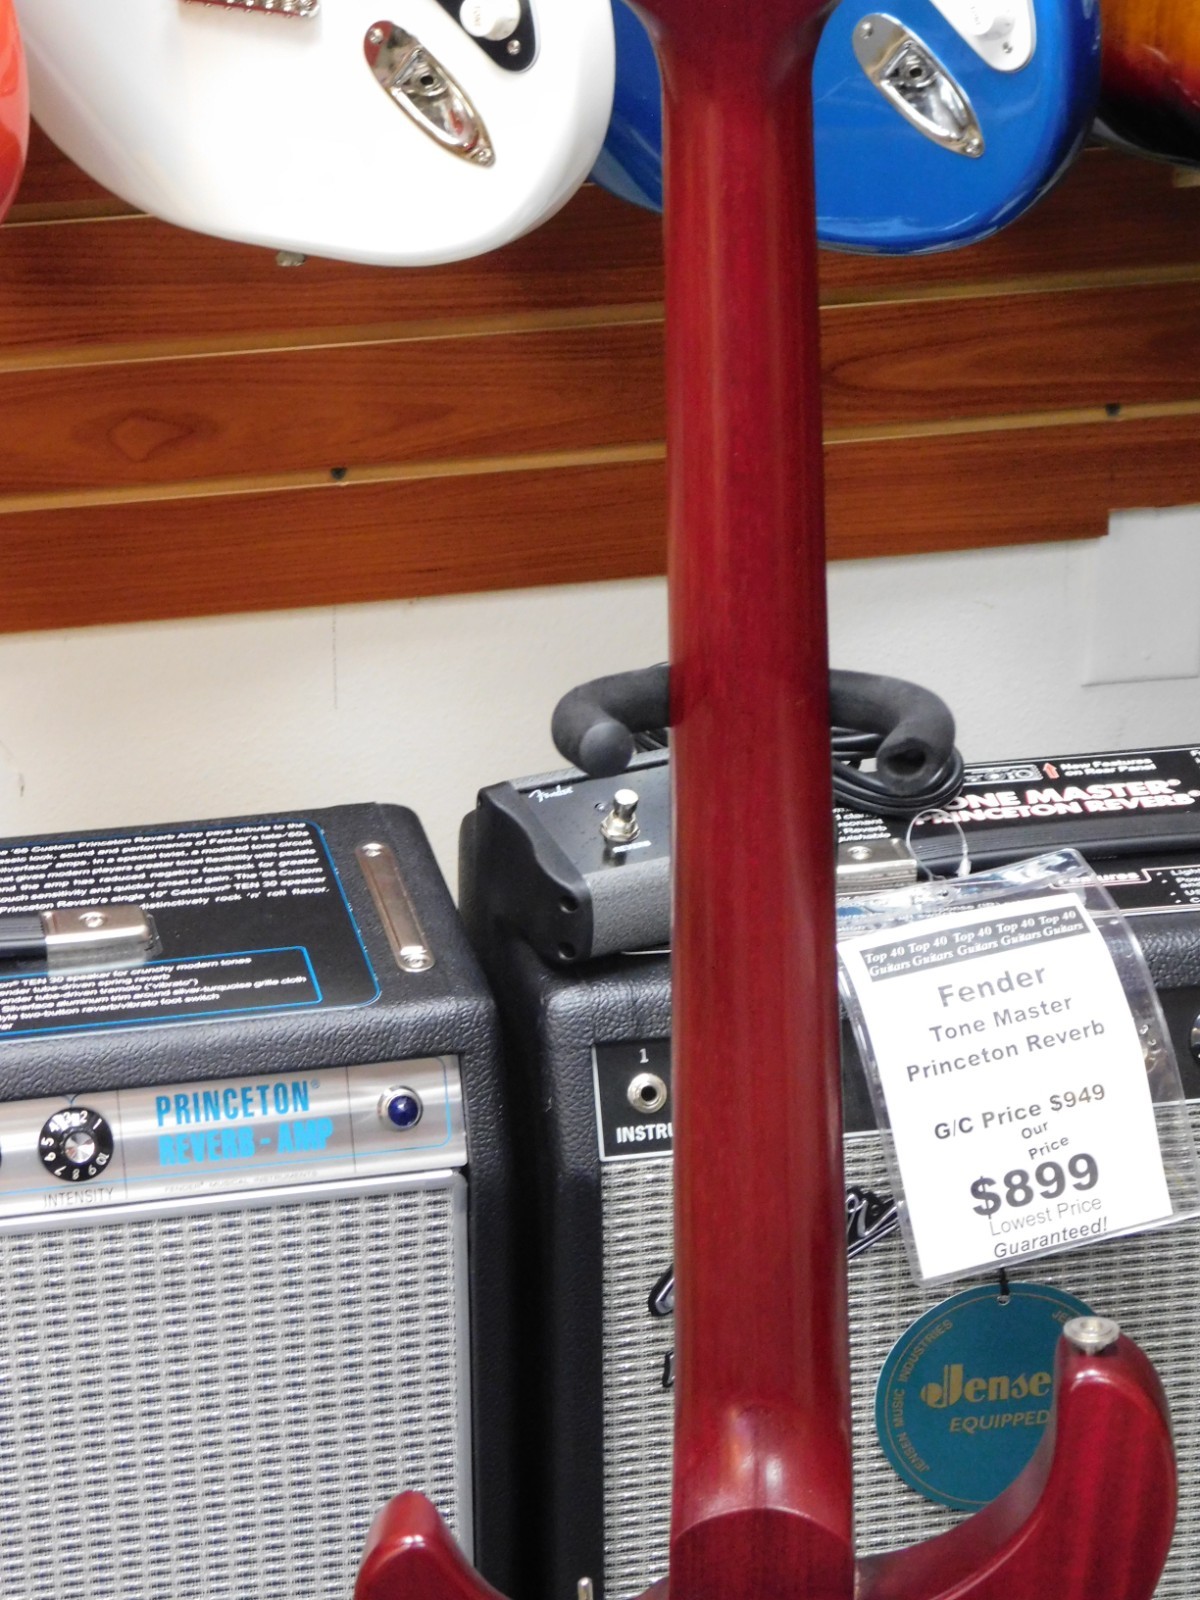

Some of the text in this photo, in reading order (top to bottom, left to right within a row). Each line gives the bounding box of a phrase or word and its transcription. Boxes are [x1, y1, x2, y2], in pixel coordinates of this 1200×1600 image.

[1092, 759, 1153, 767] Features
[1118, 764, 1157, 772] Panel
[528, 785, 574, 802] Fender
[943, 791, 1021, 810] ONE
[31, 844, 75, 853] Custom
[77, 838, 131, 848] Princeton
[134, 834, 175, 844] Reverb
[206, 829, 233, 837] pays
[235, 826, 271, 834] tribute
[60, 850, 95, 859] sound
[98, 848, 119, 856] and
[122, 841, 192, 854] performance
[209, 835, 259, 844] Fender's
[117, 853, 157, 863] special
[201, 845, 249, 854] modified
[251, 842, 277, 850] tone
[278, 839, 313, 848] circuit
[16, 849, 316, 883] gives modern players greater tonal flexibility with pedals
[44, 880, 69, 889] amp
[73, 878, 95, 886] has
[99, 873, 146, 883] reduced
[150, 868, 198, 879] negative
[203, 863, 255, 874] feedback
[278, 858, 319, 867] greater
[0, 894, 29, 903] ouch
[31, 888, 87, 900] sensitivity
[89, 886, 111, 894] and
[114, 882, 155, 892] quicker
[157, 878, 189, 888] onset
[191, 877, 202, 885] of
[204, 875, 232, 884] gain.
[279, 867, 323, 876] Custom
[0, 902, 54, 914] Princeton
[57, 897, 108, 908] Reverb's
[111, 893, 145, 903] single
[233, 882, 260, 890] TEN
[263, 880, 277, 888] 30
[280, 876, 326, 886] speaker
[215, 893, 242, 902] rock
[292, 887, 329, 895] flavor.
[864, 910, 1076, 964] Top 40 Top 40 Top 40 Top 40 Top 40
[870, 922, 1084, 977] Guitars Guitars Guitars Guitars Guitars
[0, 973, 170, 996] ender tube-driven spring reverb
[22, 978, 47, 986] TEN
[66, 972, 111, 982] speaker
[113, 970, 128, 978] for
[130, 964, 174, 976] crunchy
[176, 960, 218, 971] modern
[220, 957, 252, 966] tones
[938, 967, 1045, 1007] Fender
[0, 995, 33, 1004] ender
[35, 989, 97, 1001] tube-driven
[100, 984, 142, 994] tremolo
[0, 1014, 18, 1023] yle
[20, 1008, 80, 1020] two-button
[82, 1000, 159, 1013] reverb/vibrato
[184, 993, 220, 1002] switch
[2, 976, 307, 1013] Silverface aluminum trim around silver-turquoise grille cloth
[929, 997, 1072, 1042] Tone Master
[639, 1048, 649, 1063] 1
[907, 1019, 1105, 1082] Princeton Reverb
[935, 1084, 1105, 1139] G/C Price $949
[158, 1117, 334, 1166] REVERB AMP
[1022, 1122, 1048, 1139] Our
[1028, 1137, 1069, 1160] Price
[44, 1186, 113, 1208] INTENSITY
[970, 1153, 1098, 1220] $899
[990, 1198, 1102, 1236] Lowest Price
[994, 1216, 1108, 1258] Guaranteed!
[898, 1319, 953, 1382] INDUSTRIES
[920, 1364, 1052, 1408] Jense
[892, 1389, 905, 1427] MUSIC
[950, 1410, 1050, 1434] EQUIPPED
